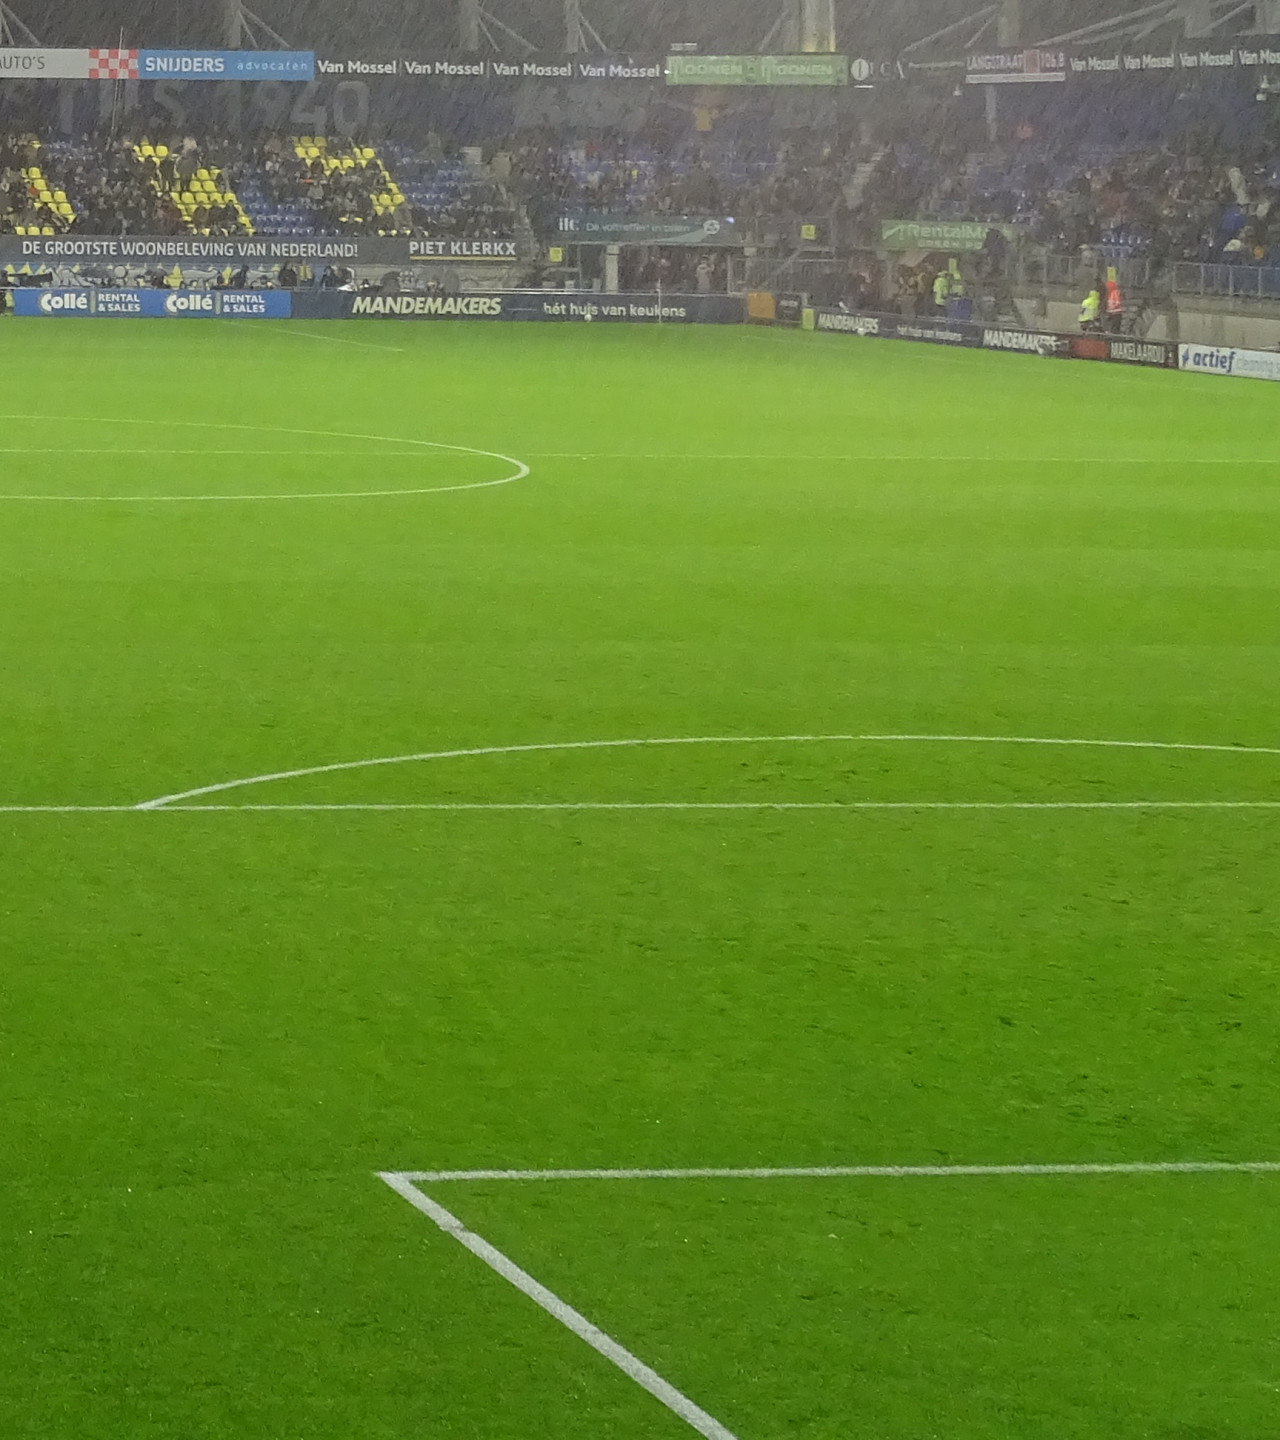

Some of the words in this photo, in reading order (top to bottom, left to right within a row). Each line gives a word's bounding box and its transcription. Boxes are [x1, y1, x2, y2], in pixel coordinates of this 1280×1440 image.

[1180, 53, 1197, 67] Van
[1200, 50, 1234, 66] Mossel
[1260, 49, 1280, 64] Mos
[146, 58, 224, 73] SNIJDERS
[237, 60, 308, 71] advocaten
[318, 61, 344, 74] Van
[348, 61, 396, 74] Mossel
[405, 62, 431, 74] Van
[436, 62, 484, 75] Mossel
[494, 63, 519, 75] Van
[524, 63, 572, 76] Mossel
[580, 64, 605, 77] Van
[610, 64, 659, 78] Mossel
[23, 241, 41, 255] DE
[45, 241, 117, 256] GROOTSTE
[121, 242, 234, 256] WOONBELEVING
[238, 242, 267, 256] VAN
[270, 243, 359, 258] NEDERLAND!
[409, 241, 446, 255] PIET
[450, 242, 516, 256] KLERKX
[40, 293, 88, 310] Collé
[98, 293, 139, 303] RENTAL
[166, 294, 213, 312] Collé
[223, 294, 265, 304] RENTAL
[98, 303, 107, 312] &
[107, 303, 141, 313] SALES
[223, 304, 232, 313] &
[232, 304, 266, 313] SALES
[352, 296, 502, 315] MANDEMAKERS
[602, 306, 627, 316] van
[630, 305, 687, 318] keukens
[1193, 349, 1236, 373] actief
